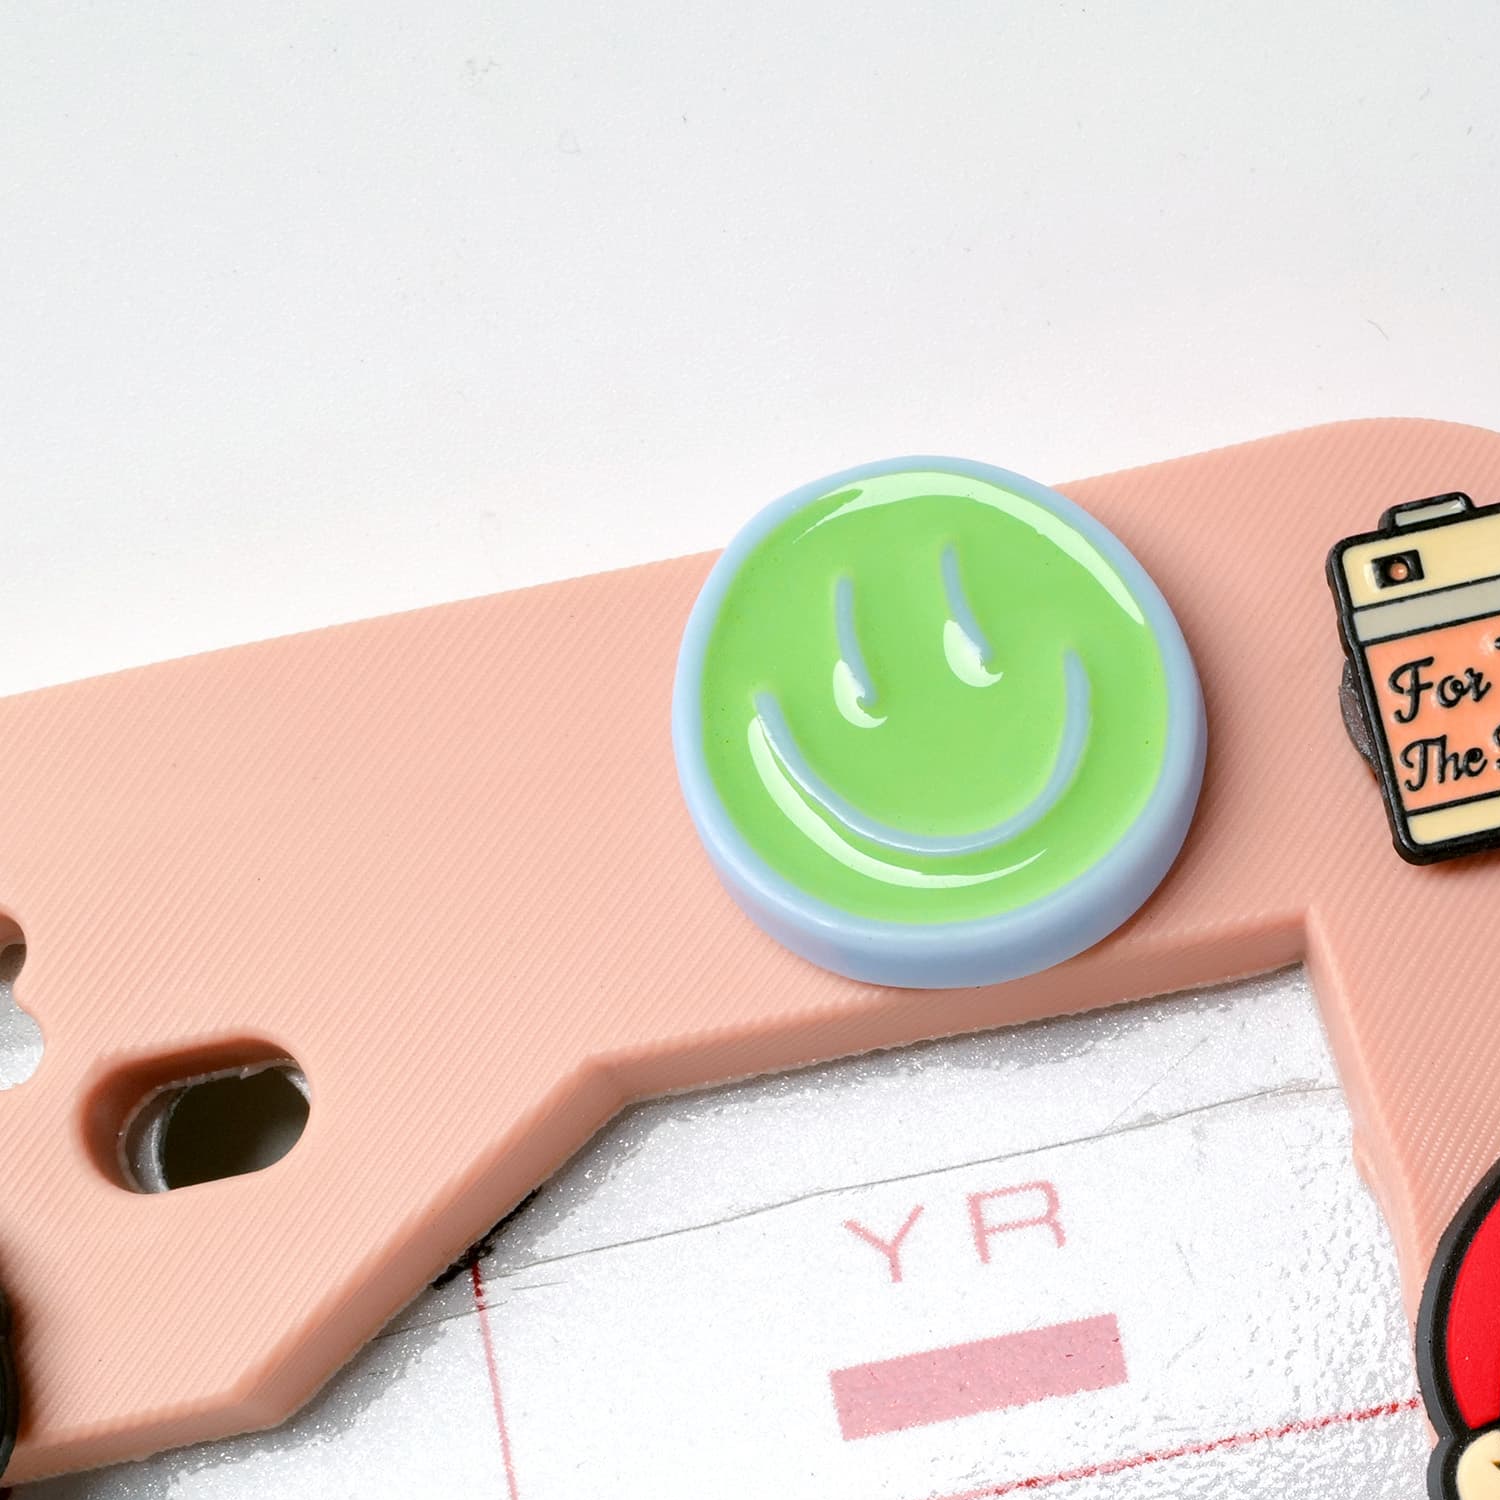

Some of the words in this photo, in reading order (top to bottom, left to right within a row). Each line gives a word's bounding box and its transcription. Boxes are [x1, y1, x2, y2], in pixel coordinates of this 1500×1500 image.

[1388, 656, 1492, 724] For
[1400, 734, 1488, 792] The
[841, 1179, 1067, 1284] YR
